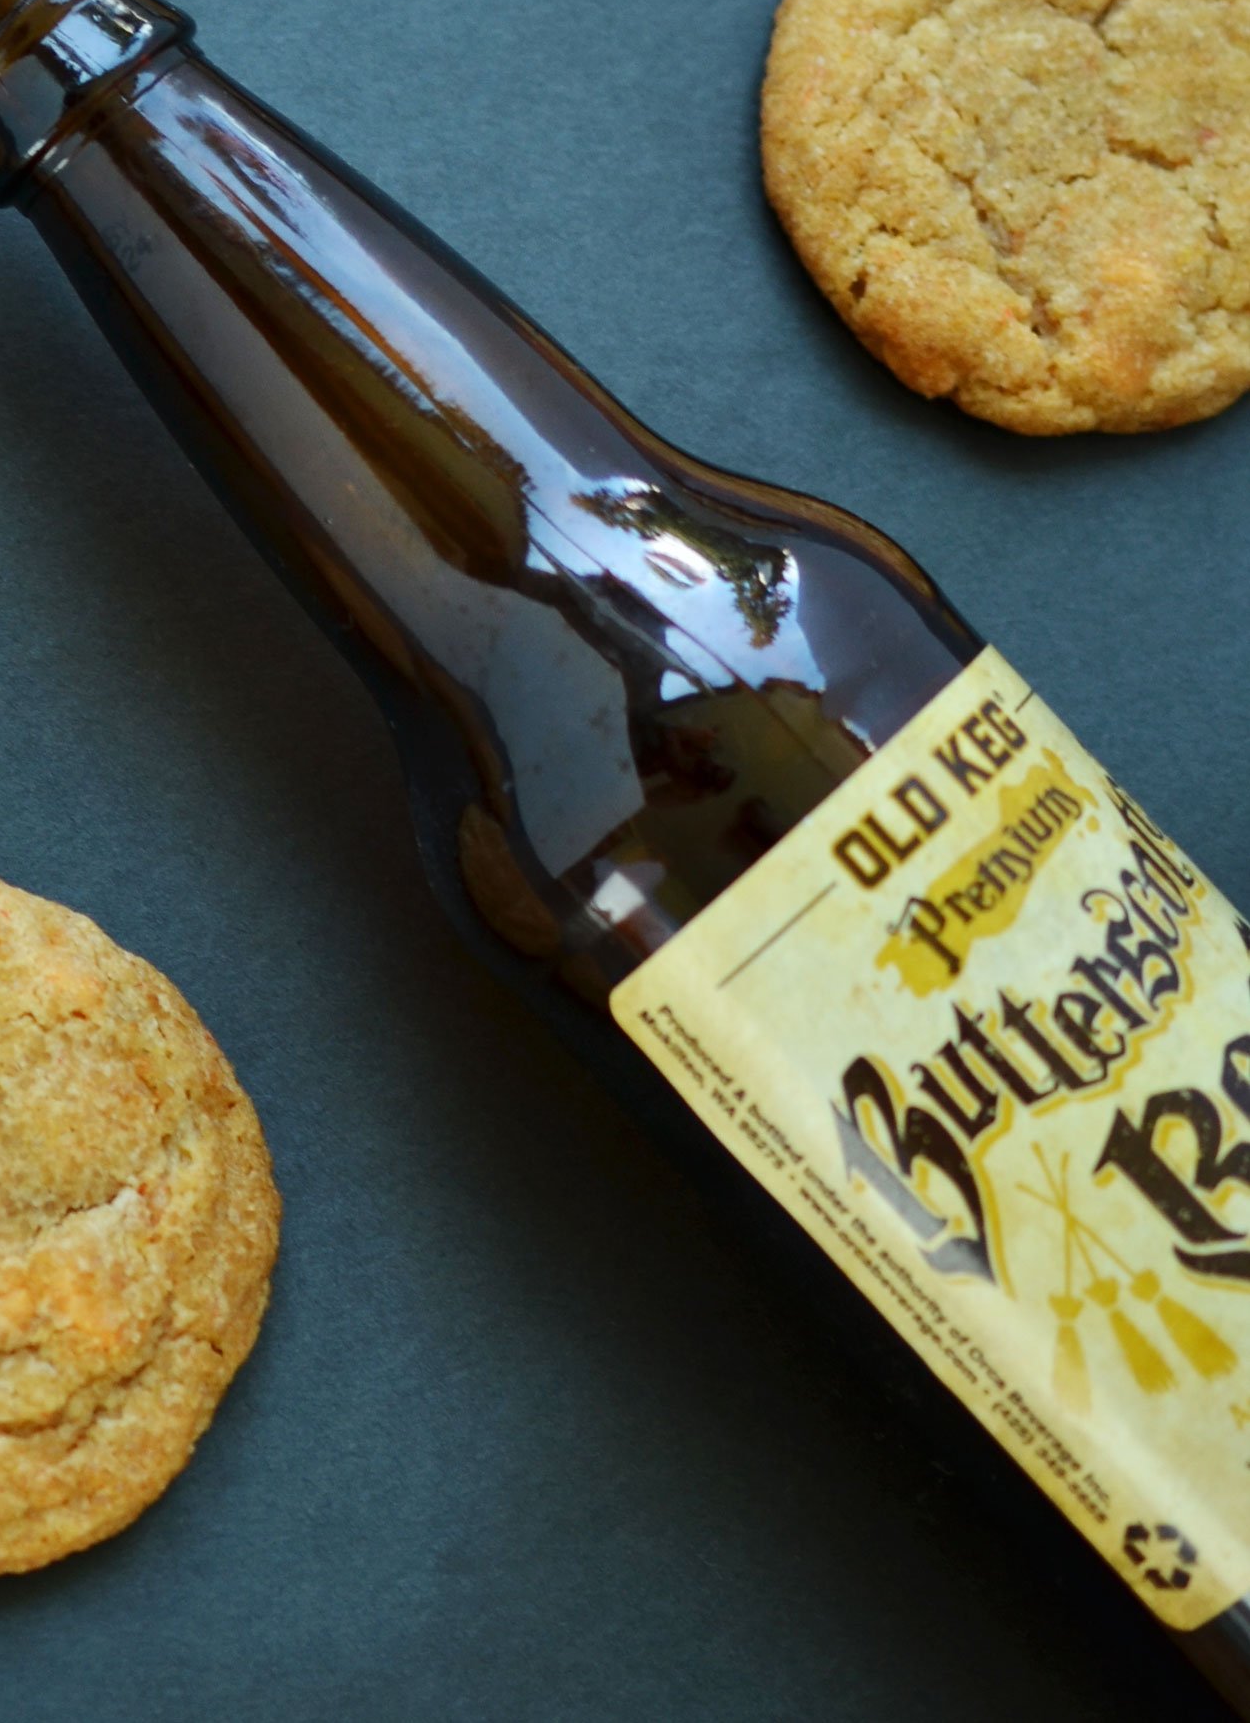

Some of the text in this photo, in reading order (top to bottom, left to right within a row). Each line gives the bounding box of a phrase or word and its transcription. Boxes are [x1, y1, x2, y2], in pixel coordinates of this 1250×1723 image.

[832, 772, 949, 889] OLD
[887, 785, 1083, 977] Premium
[711, 1089, 736, 1115] WA
[659, 1006, 732, 1085] Produced
[748, 1105, 803, 1162] bottled
[805, 1167, 848, 1213] under
[852, 1218, 876, 1244] the
[880, 1250, 946, 1324] authority
[968, 1348, 1005, 1388] Orca
[1008, 1392, 1081, 1473] Beverage
